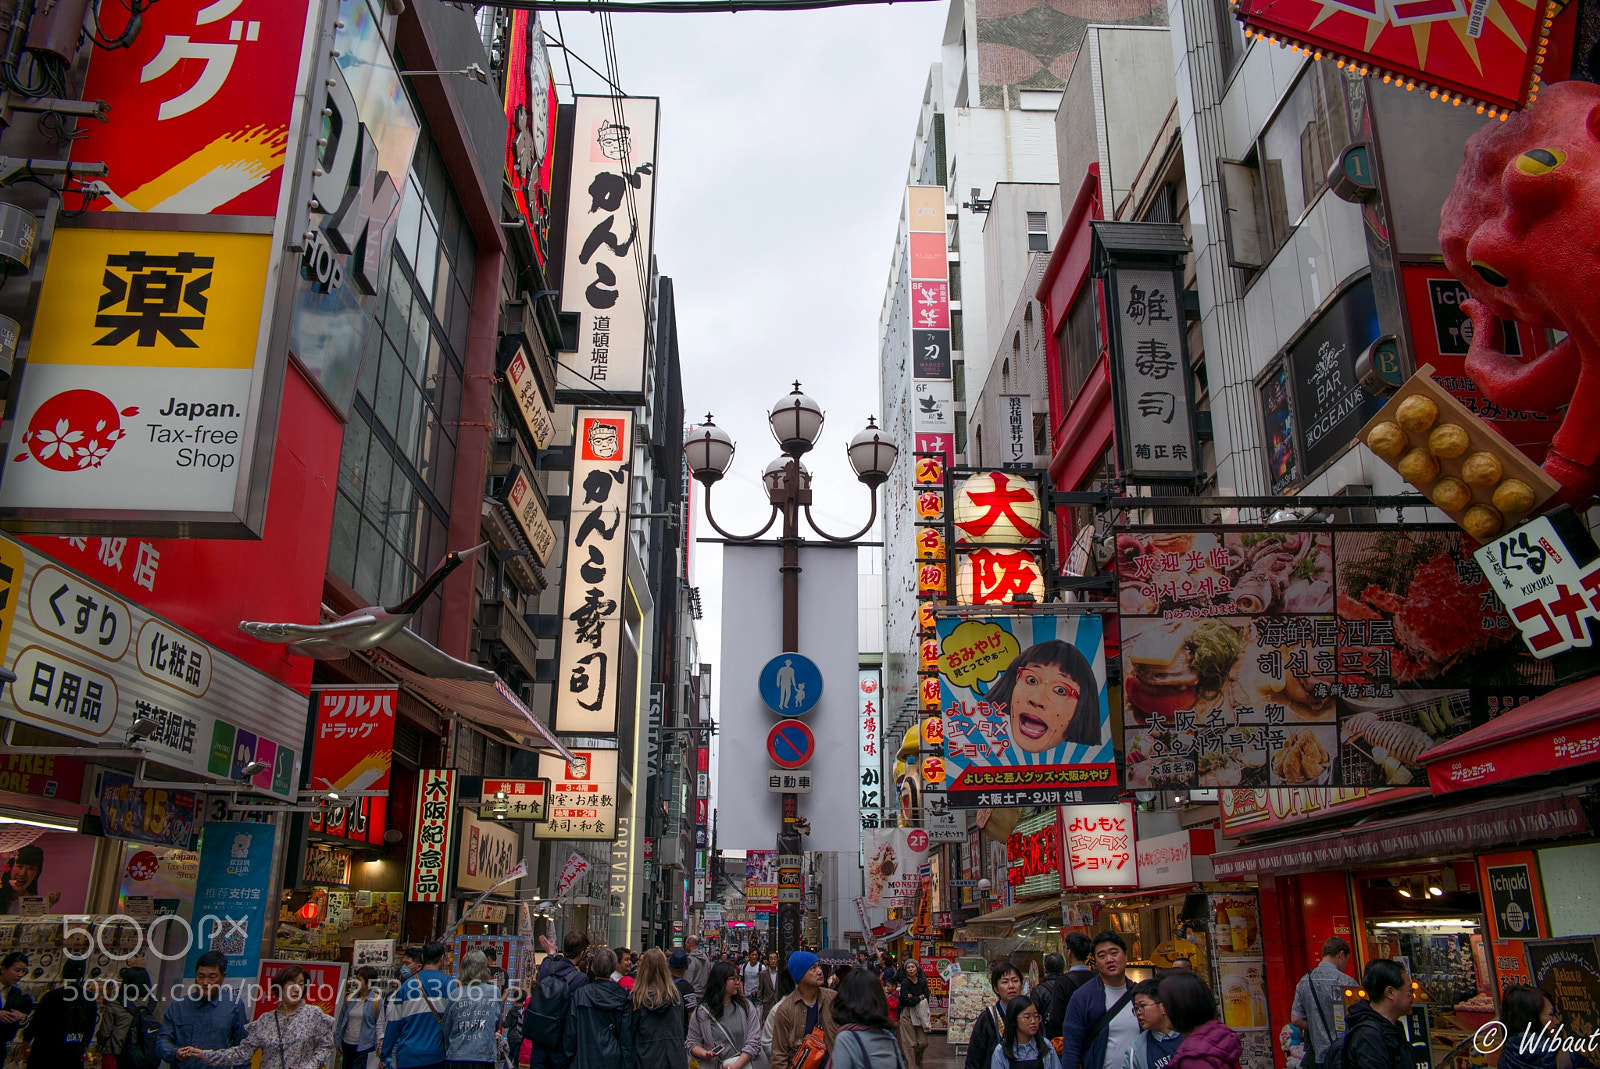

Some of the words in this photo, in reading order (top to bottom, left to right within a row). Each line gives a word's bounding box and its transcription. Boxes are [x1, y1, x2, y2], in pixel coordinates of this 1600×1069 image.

[92, 250, 215, 349] 薬
[589, 315, 611, 381] 道頓堀店
[916, 384, 928, 392] 6F
[1316, 375, 1342, 404] BAR
[159, 397, 241, 421] Japan.
[147, 423, 238, 445] Tax-free
[176, 448, 236, 473] Shop
[1135, 444, 1188, 461] 菊正宗
[1133, 548, 1230, 577] 欢迎光临
[1500, 532, 1546, 575] くくる
[1141, 576, 1234, 602] 어서오세요
[1520, 575, 1554, 596] KUKURU
[49, 583, 117, 646] くすり
[1164, 604, 1237, 620] いらっしゃいませ
[1483, 616, 1509, 629] かに
[149, 631, 202, 688] 化粧品
[946, 631, 1002, 669] おみやげ
[1257, 649, 1394, 679] 해선호프집
[28, 661, 103, 723] 日用品
[1313, 683, 1394, 698] 海鮮居酒屋
[323, 694, 393, 718] ツルハ
[945, 701, 1008, 718] よしもと
[862, 700, 877, 757] 本場の味
[947, 719, 1008, 738] エンタメ
[1145, 703, 1286, 734] 大阪名产物
[320, 722, 379, 739] ドラッグ
[948, 739, 1010, 758] ショップ
[1151, 729, 1287, 759] 오오사까특산품
[8, 754, 56, 777] FREE
[1150, 761, 1195, 776] 大阪名物
[769, 775, 811, 788] 自動車
[963, 769, 1110, 785] よしもと芸人グッズ・大阪みやげ
[500, 783, 526, 794] 地階
[1063, 790, 1083, 803] 선물
[1069, 817, 1125, 832] よしもと
[416, 777, 448, 894] 大阪紀念品
[909, 835, 927, 847] 2F
[1070, 834, 1128, 852] エンタメ
[170, 852, 198, 861] Japan.
[610, 817, 629, 893] FOREVER
[1071, 853, 1130, 870] ショップ
[166, 863, 197, 871] Tax-free
[176, 871, 197, 880] Shop
[747, 887, 772, 897] REVUE
